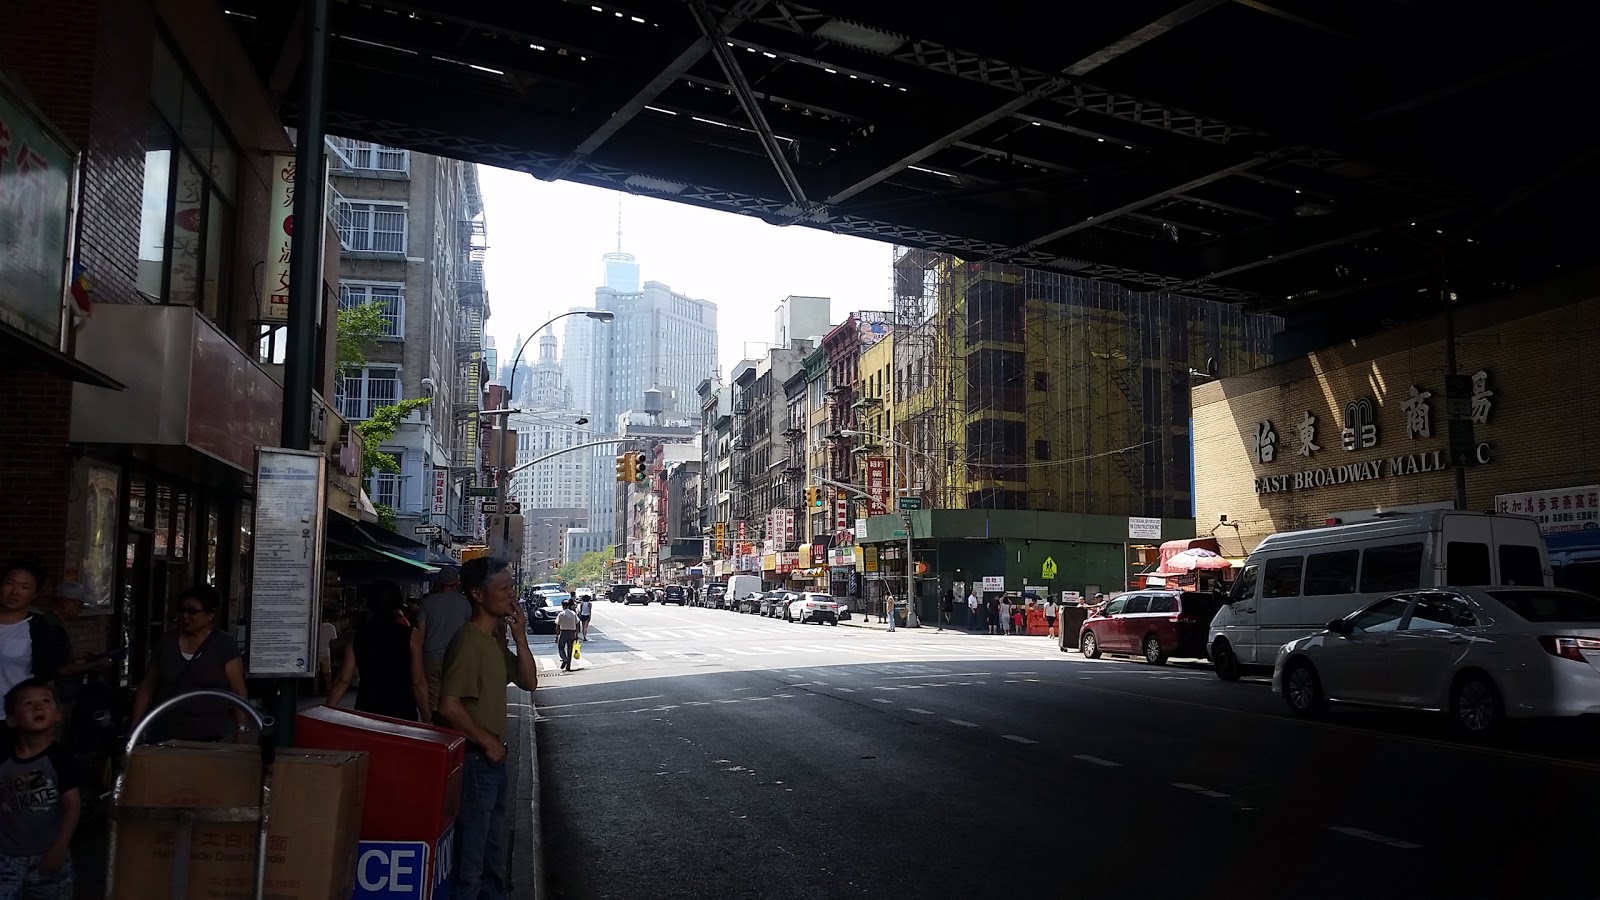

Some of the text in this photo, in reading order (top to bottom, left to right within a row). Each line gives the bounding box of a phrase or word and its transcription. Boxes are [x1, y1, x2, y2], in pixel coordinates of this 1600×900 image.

[1253, 474, 1289, 494] EAST
[1294, 460, 1383, 490] BROADWAY
[1390, 450, 1446, 477] MALL
